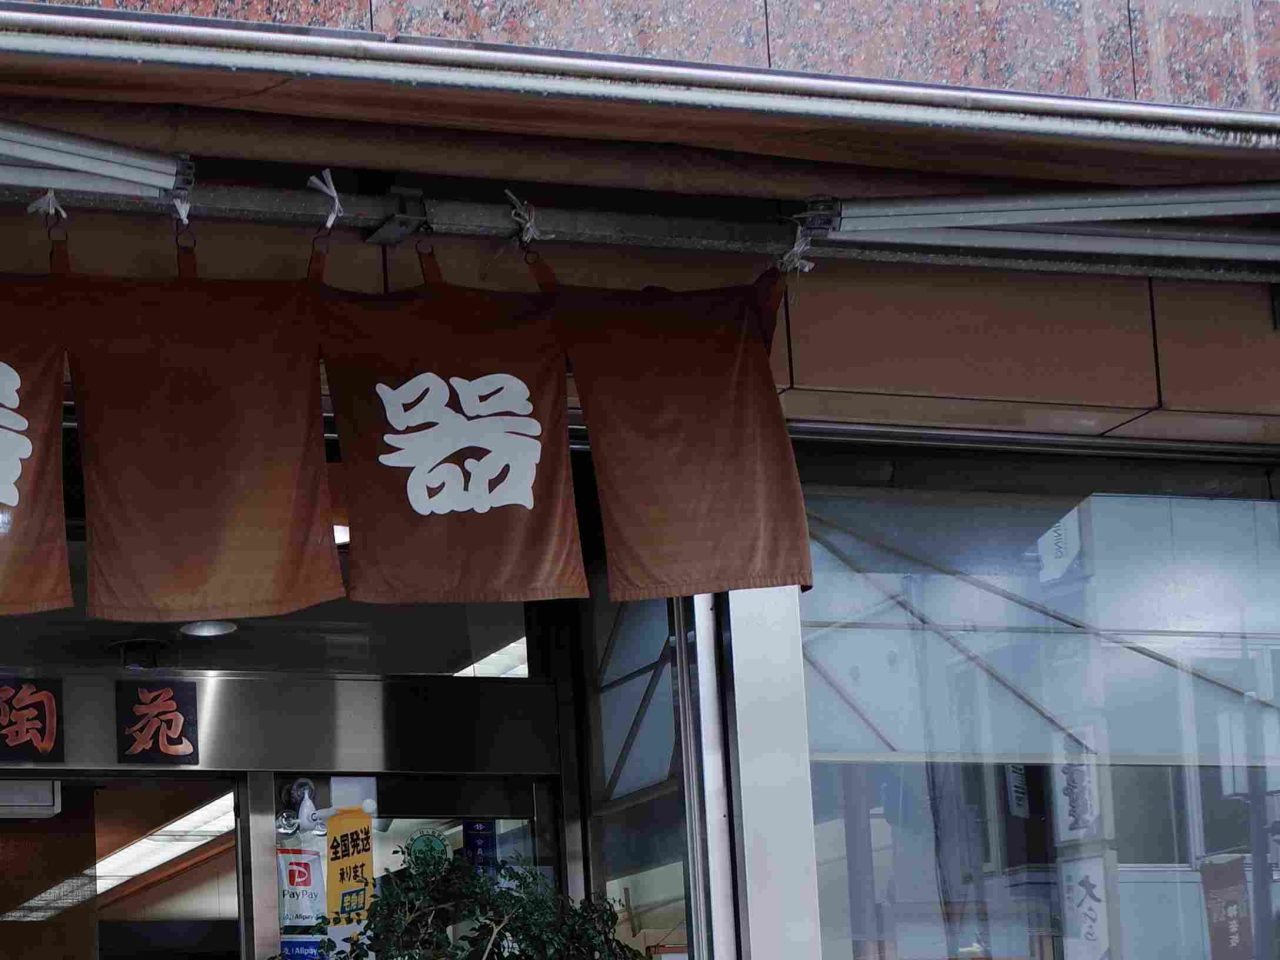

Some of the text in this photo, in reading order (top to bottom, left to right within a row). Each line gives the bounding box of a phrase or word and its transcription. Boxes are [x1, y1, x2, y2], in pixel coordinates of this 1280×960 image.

[376, 372, 543, 516] 器
[329, 826, 371, 862] 全国発送
[282, 890, 319, 900] PayPay
